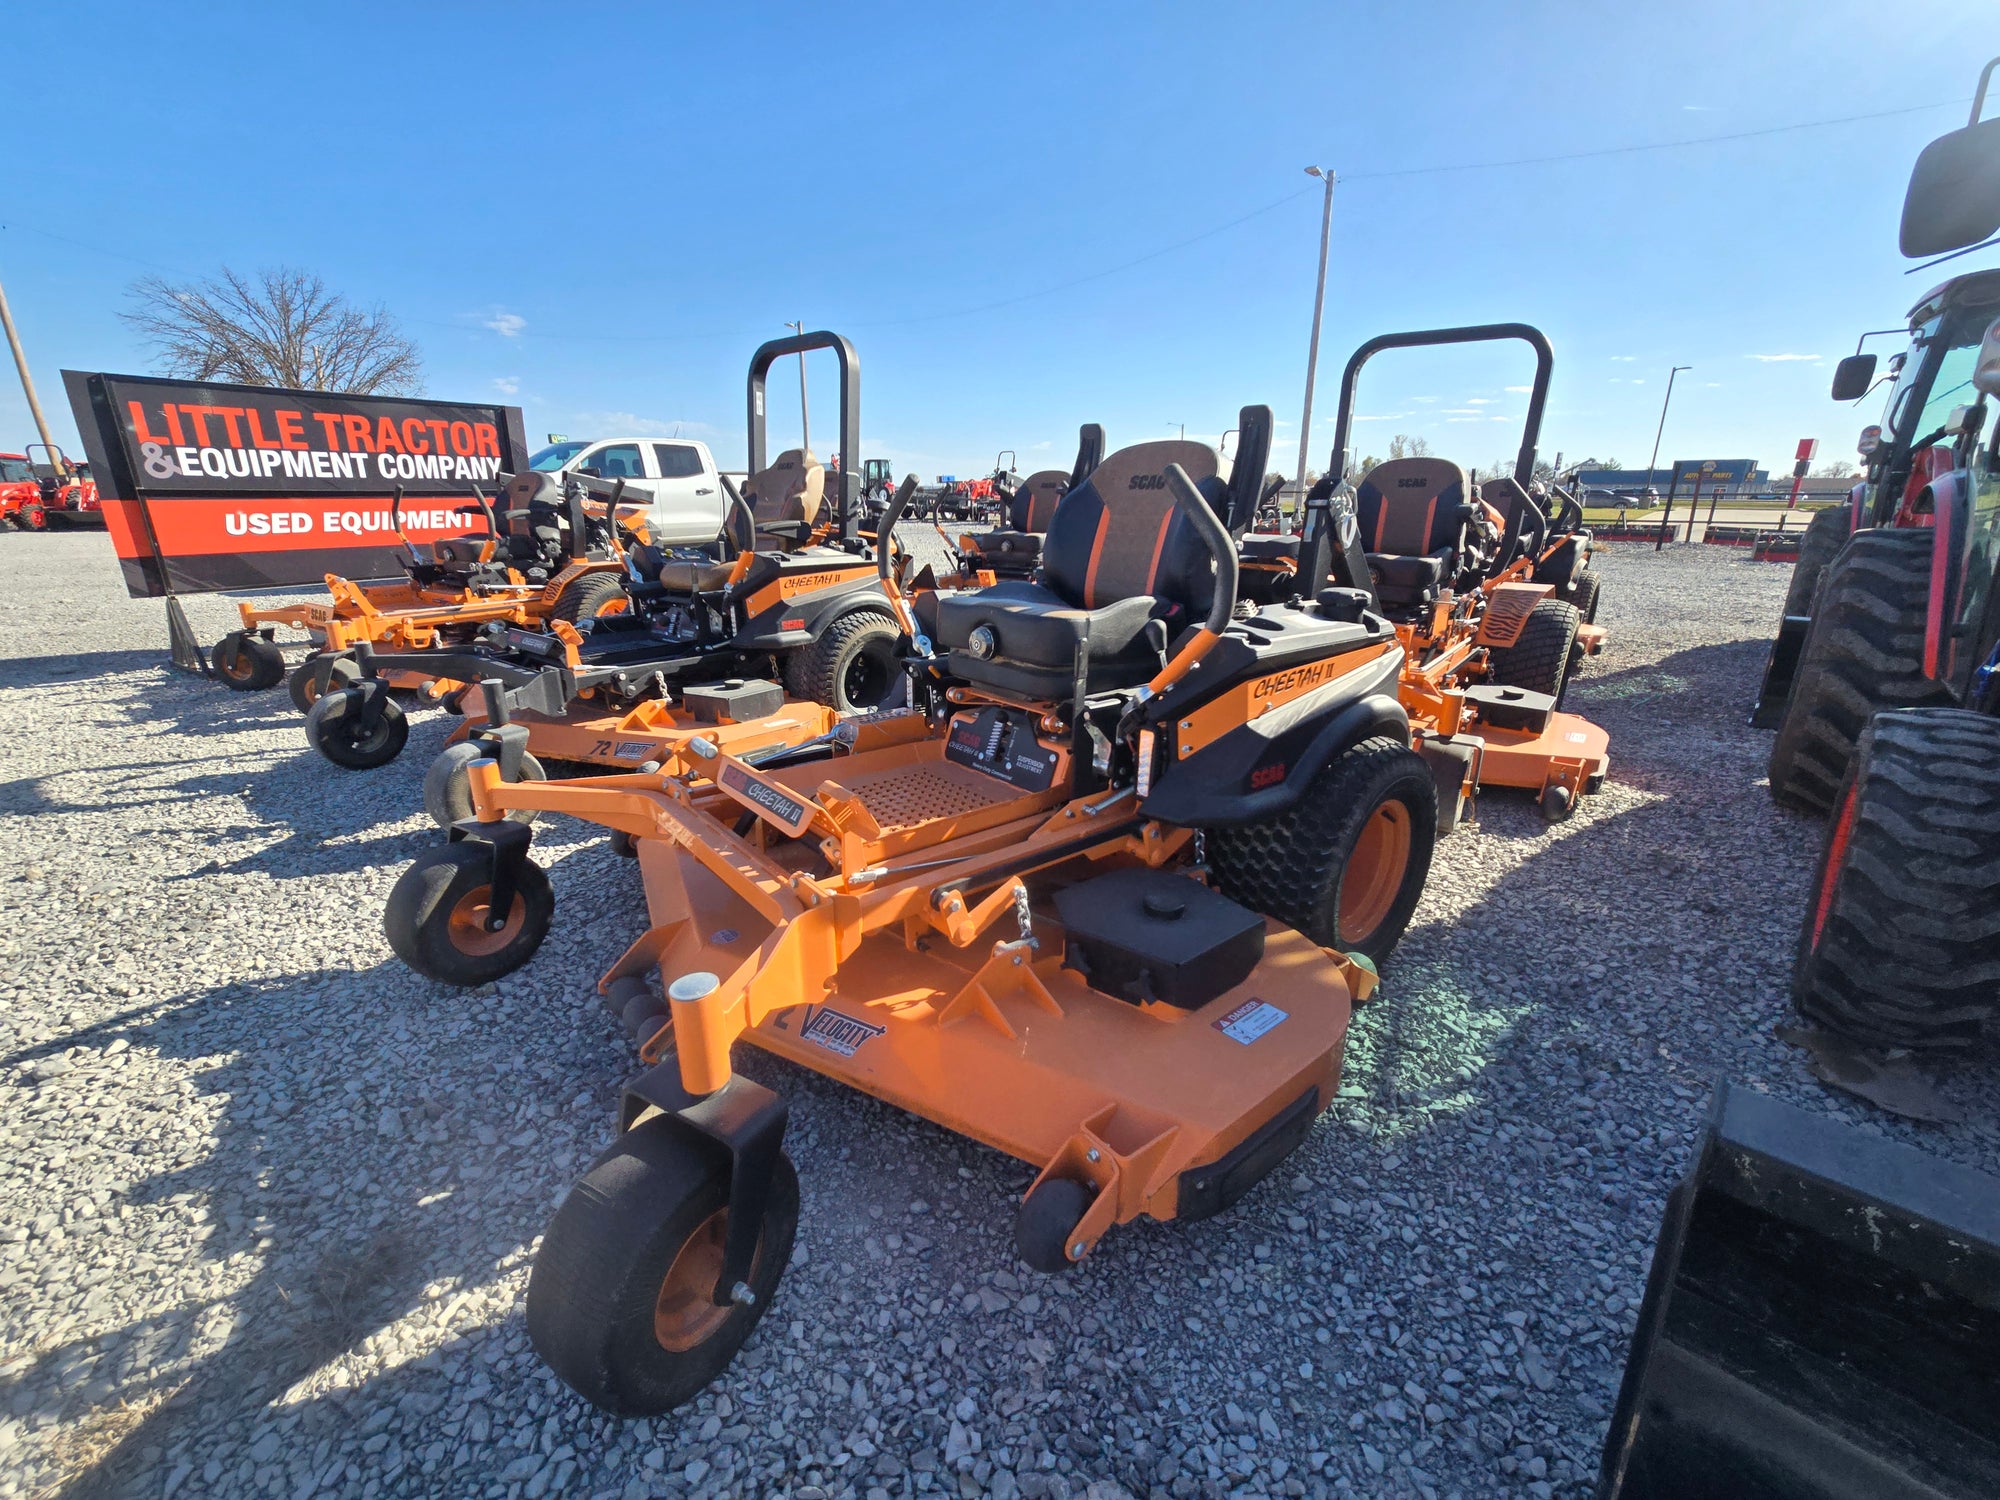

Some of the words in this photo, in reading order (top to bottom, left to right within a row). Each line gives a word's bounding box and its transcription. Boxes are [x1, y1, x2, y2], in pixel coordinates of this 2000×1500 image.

[128, 401, 309, 450] LITTLE
[313, 412, 500, 457] TRACTOR
[377, 453, 501, 480] COMPANY
[1128, 475, 1165, 490] SCAG
[224, 511, 313, 536] USED
[323, 510, 472, 535] EQUIPMENT
[783, 574, 834, 589] CHEETAH
[1254, 663, 1325, 699] CHEETAH
[590, 740, 612, 756] 72
[748, 783, 794, 817] CHEETAH
[1227, 1000, 1260, 1021] DANGER
[800, 1003, 882, 1048] VELOCITY
